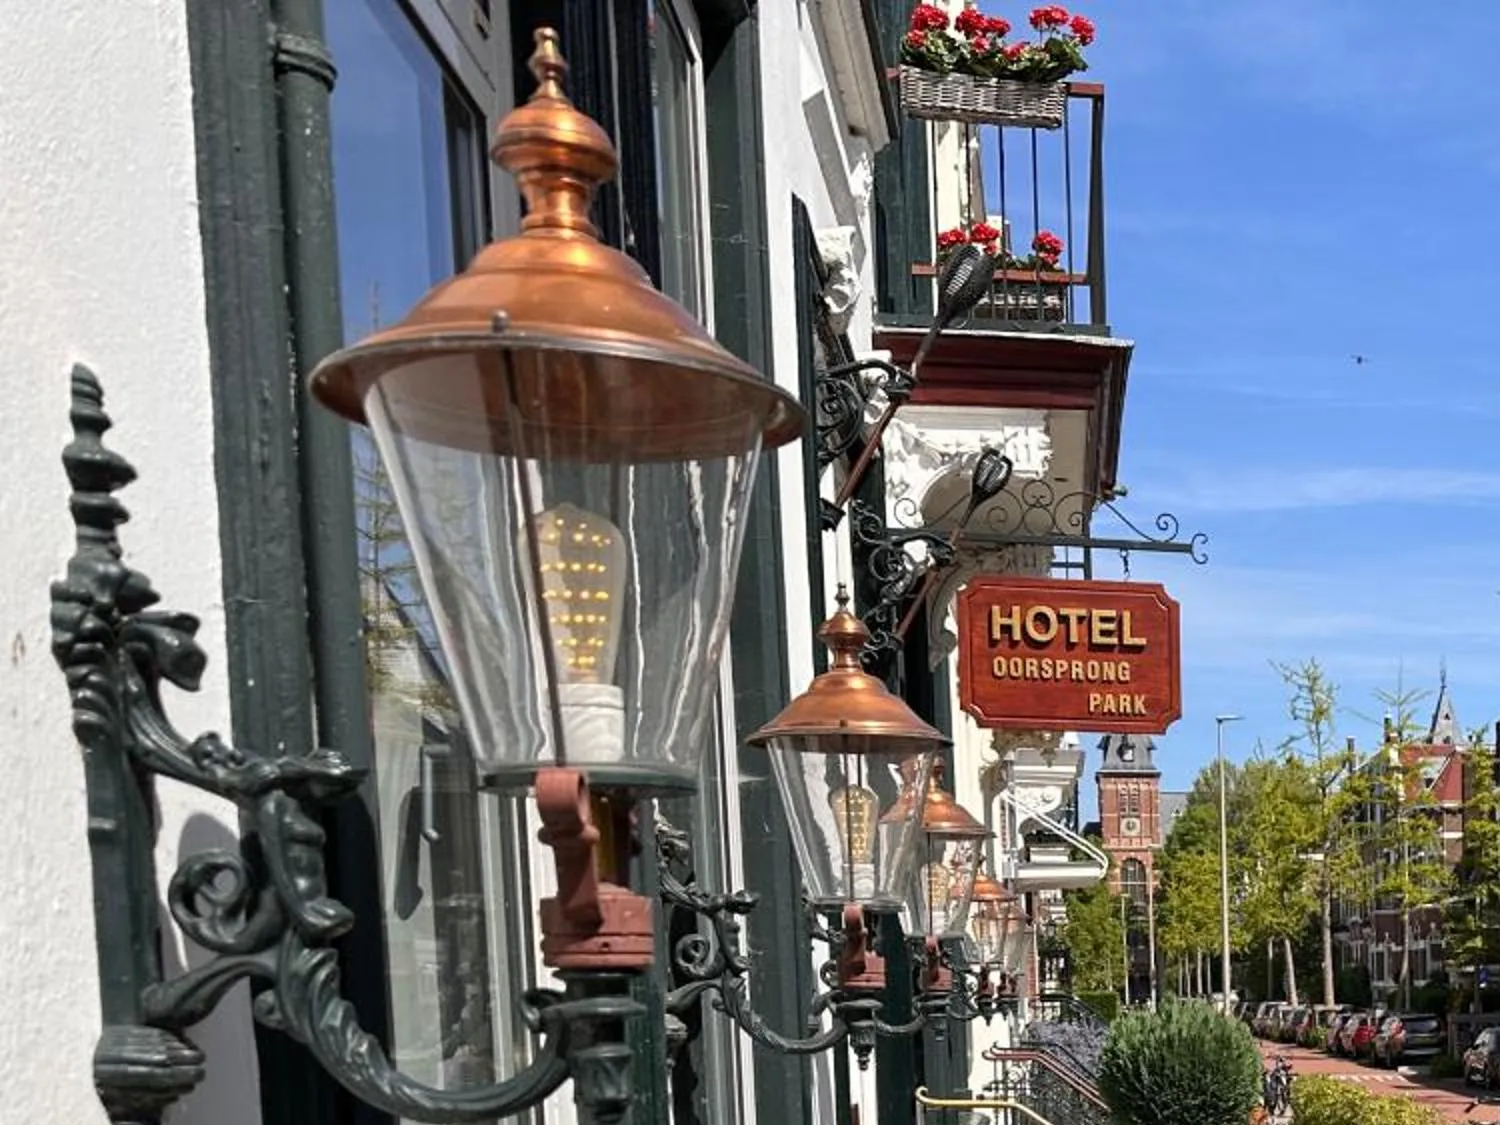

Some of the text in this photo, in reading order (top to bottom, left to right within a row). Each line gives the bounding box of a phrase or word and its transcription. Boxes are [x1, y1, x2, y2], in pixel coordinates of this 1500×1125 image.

[990, 604, 1148, 646] HOTEL
[992, 655, 1132, 682] OORSPRONG
[1089, 692, 1148, 716] PARK
